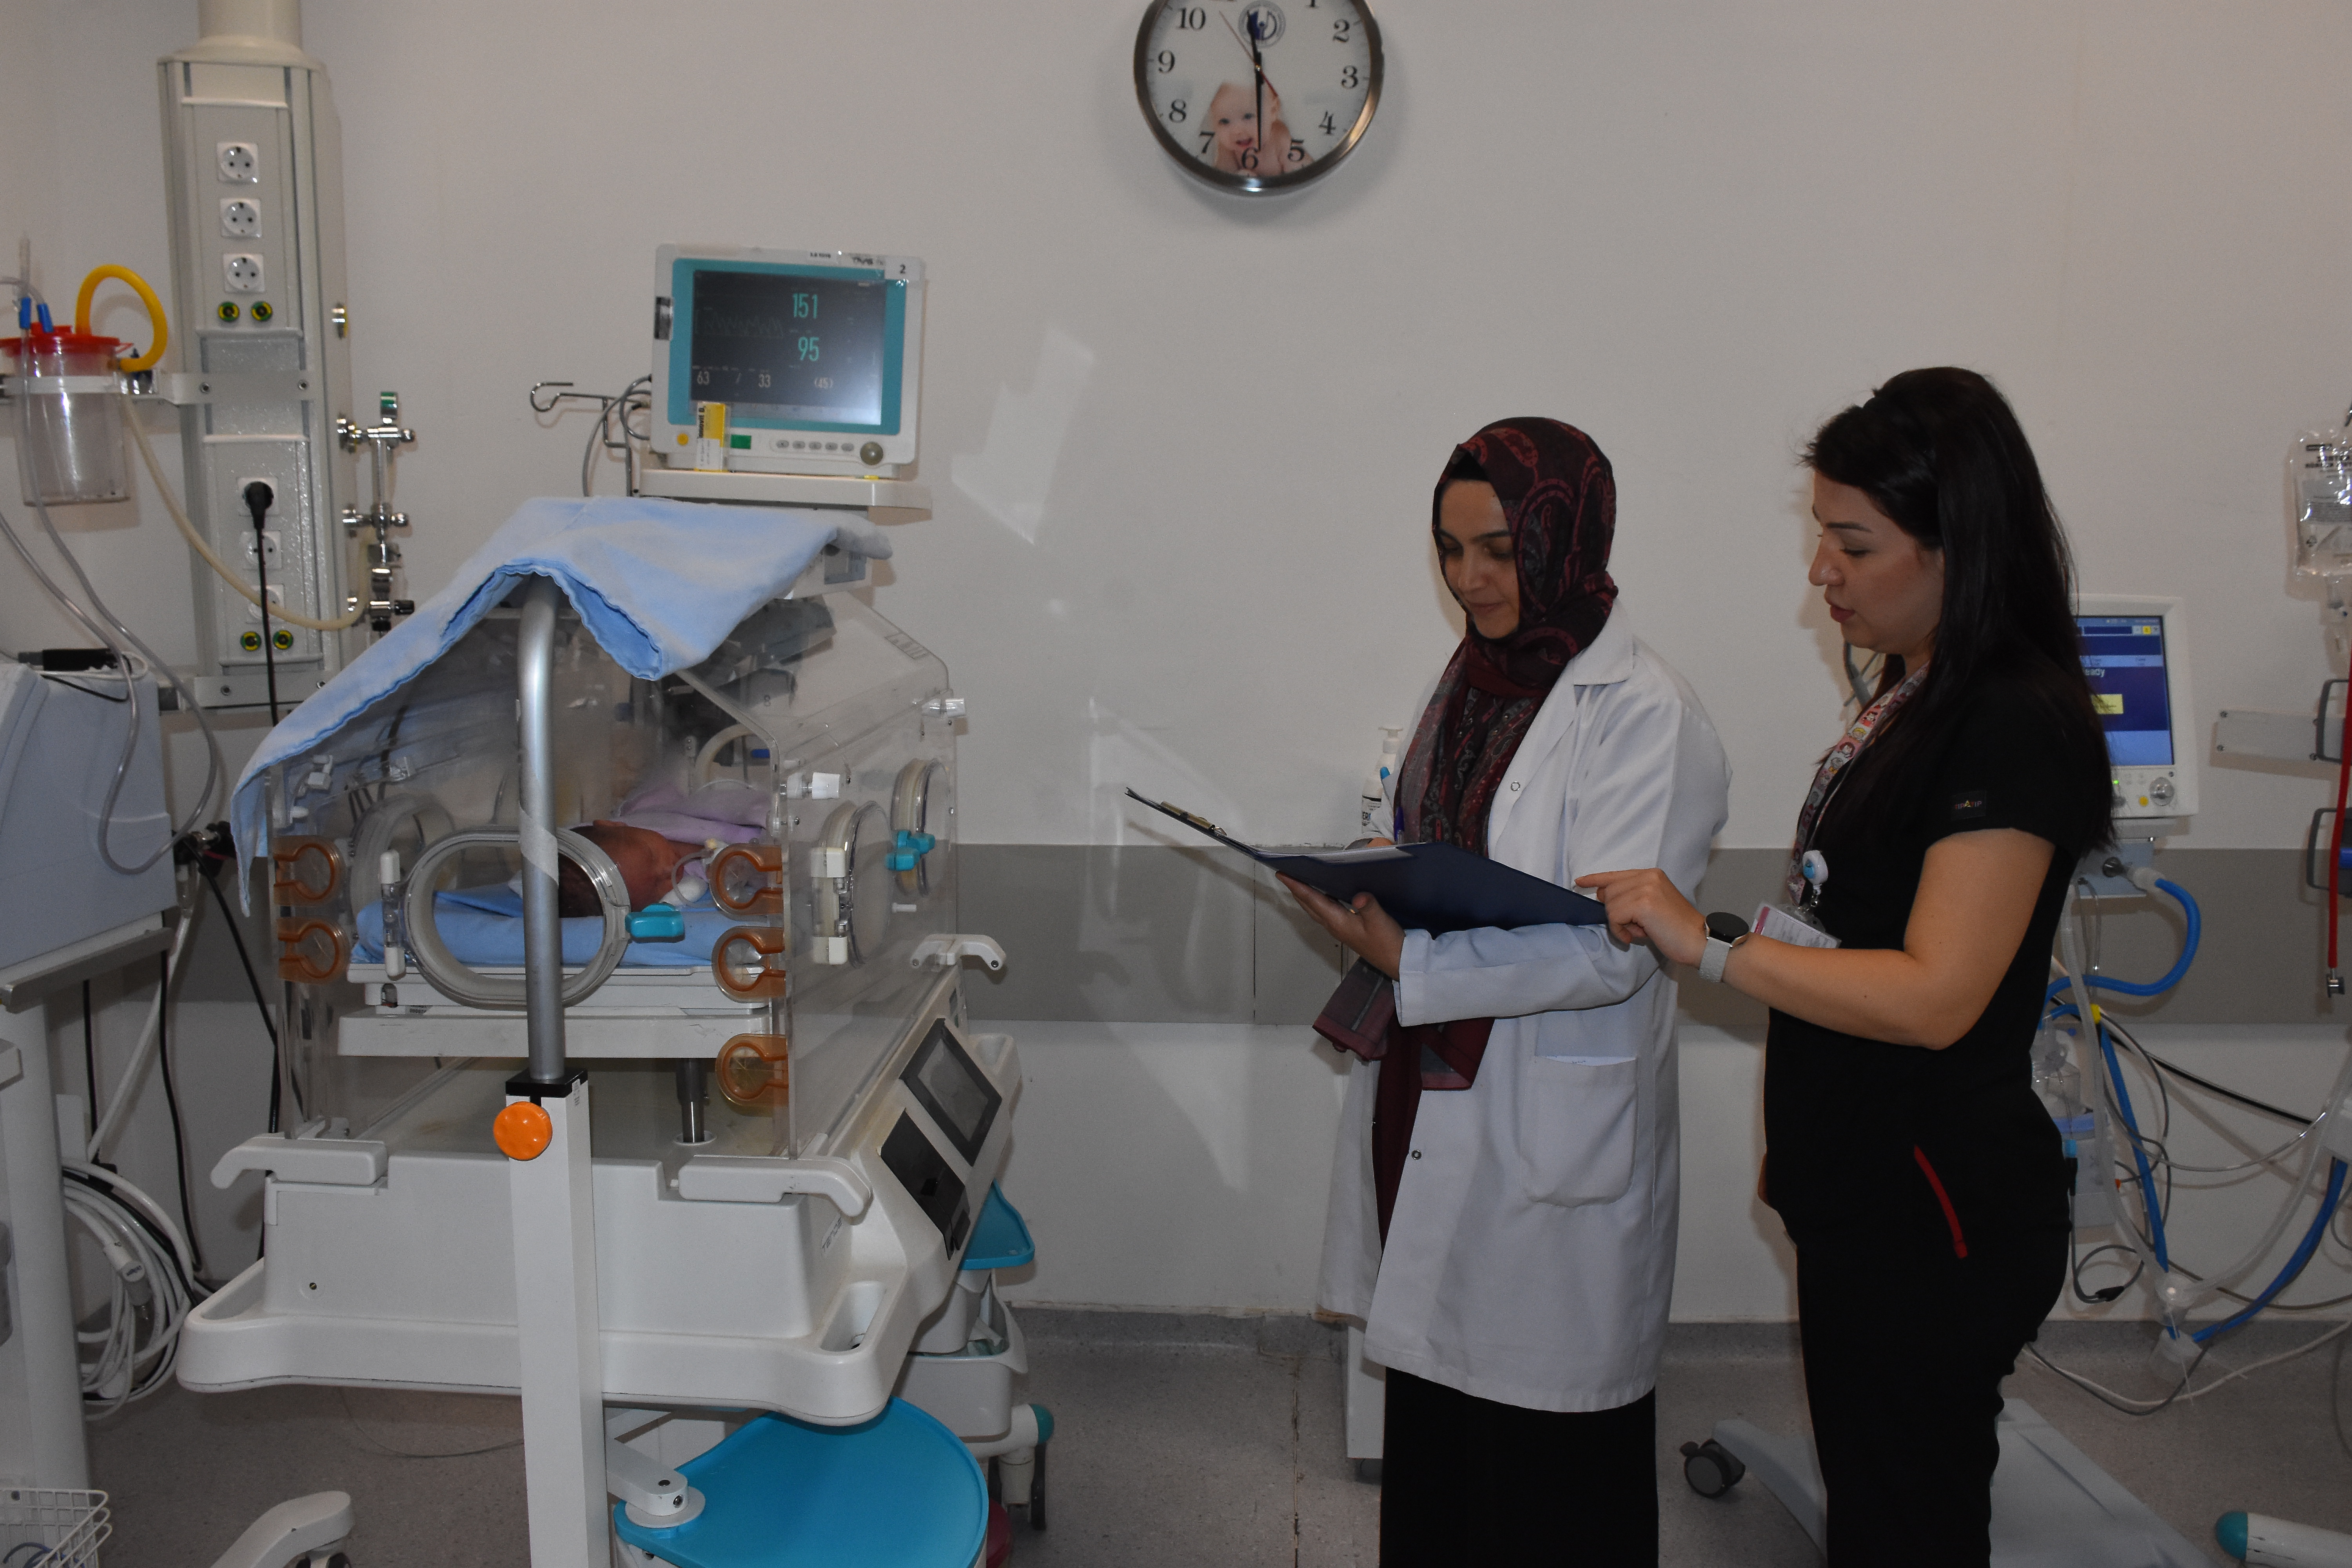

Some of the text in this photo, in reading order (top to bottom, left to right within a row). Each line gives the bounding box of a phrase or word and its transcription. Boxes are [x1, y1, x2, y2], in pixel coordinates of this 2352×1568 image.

[1177, 7, 1206, 30] 10
[1333, 19, 1350, 43] 2
[1158, 51, 1175, 73] 9
[1341, 65, 1358, 89] 3
[1169, 99, 1187, 122] 8
[1319, 111, 1336, 134] 4
[1200, 131, 1216, 153] 7
[1288, 139, 1305, 162] 5
[1241, 147, 1259, 170] 6
[900, 264, 906, 274] 2
[793, 293, 818, 319] 151
[798, 336, 820, 362] 95
[697, 371, 710, 385] 63
[758, 373, 771, 388] 33
